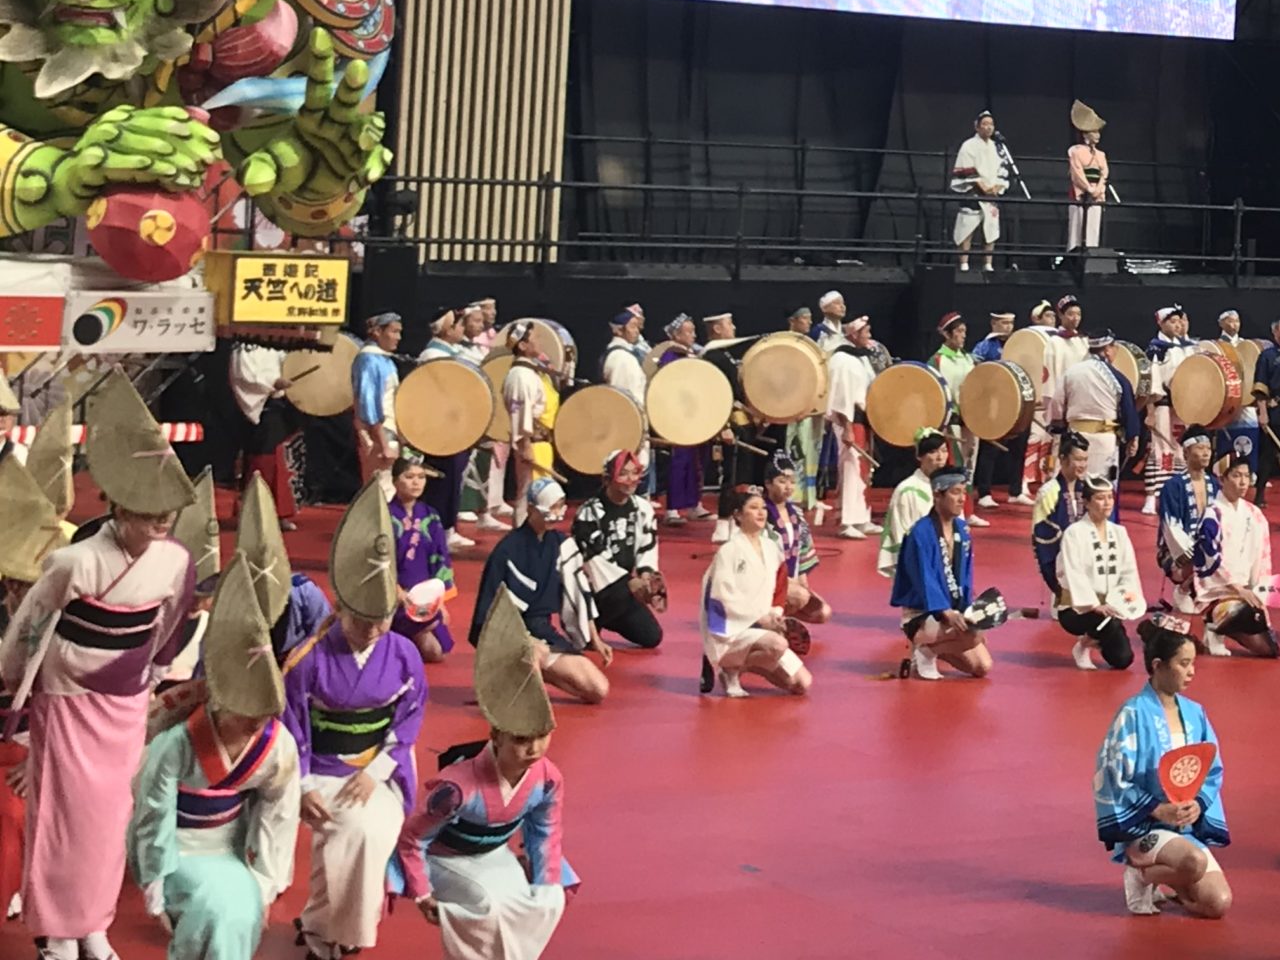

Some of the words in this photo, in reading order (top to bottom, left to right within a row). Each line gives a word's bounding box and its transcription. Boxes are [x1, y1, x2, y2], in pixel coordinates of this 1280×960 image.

[241, 277, 339, 303] 天竺への道
